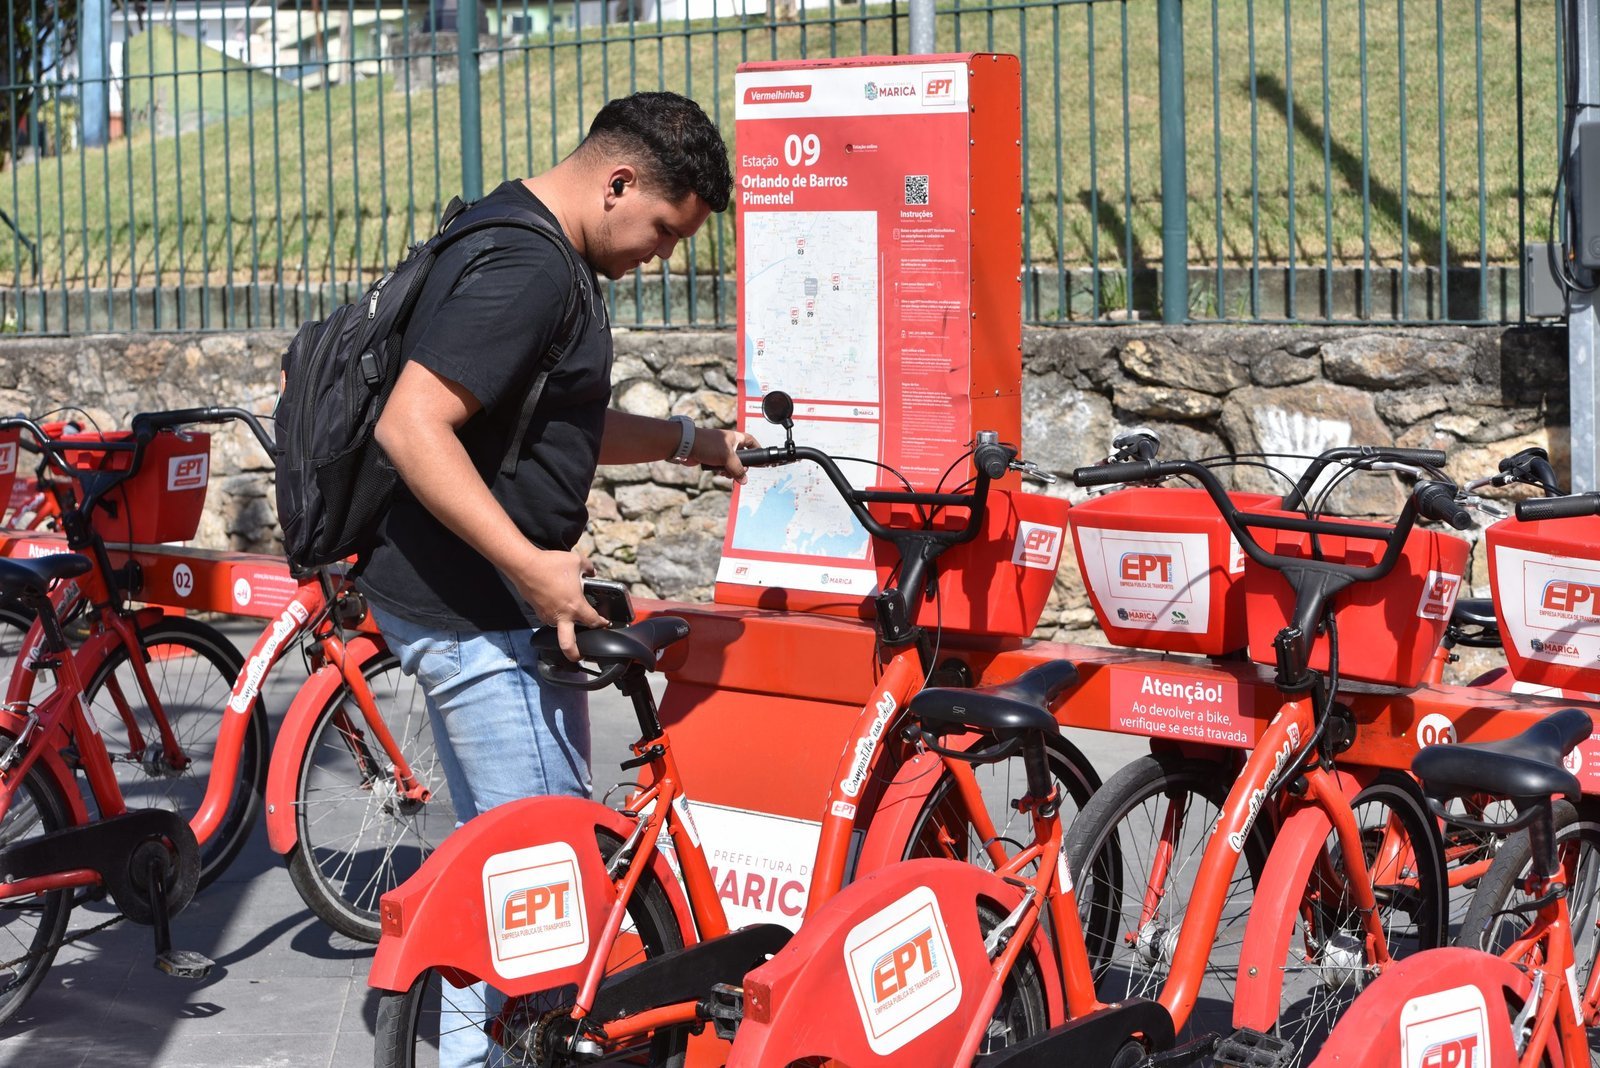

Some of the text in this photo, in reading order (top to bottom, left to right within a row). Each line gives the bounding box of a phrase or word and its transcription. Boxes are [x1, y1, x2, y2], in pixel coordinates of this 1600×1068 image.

[751, 90, 805, 101] Vermelhinhas
[926, 79, 952, 95] EPT
[742, 133, 821, 169] Estação 09
[741, 173, 848, 188] Orlando de Barros
[742, 191, 794, 205] Pimentel
[900, 210, 934, 219] Instruções
[175, 458, 204, 477] EPT
[1025, 529, 1057, 552] EPT
[176, 571, 191, 588] 02
[1122, 554, 1172, 583] EPT
[1428, 578, 1457, 602] EPT
[1141, 675, 1223, 704] Atenção!
[1132, 702, 1232, 726] Ao devolver a bike,
[1120, 717, 1248, 743] verifique se está travada
[1422, 724, 1453, 747] 06
[844, 739, 875, 794] Compartilhe
[834, 804, 855, 815] EPT
[713, 850, 814, 877] PREFEITURA D
[504, 881, 570, 931] EPT
[501, 931, 519, 940] EMPRESA
[519, 928, 537, 937] PÚBLICA
[543, 920, 571, 931] TRANSPORTES
[873, 928, 933, 1004] EPT
[875, 1000, 893, 1015] EMPRESA
[893, 989, 909, 1003] PÚBLICA
[914, 969, 941, 991] TRANSPORTES
